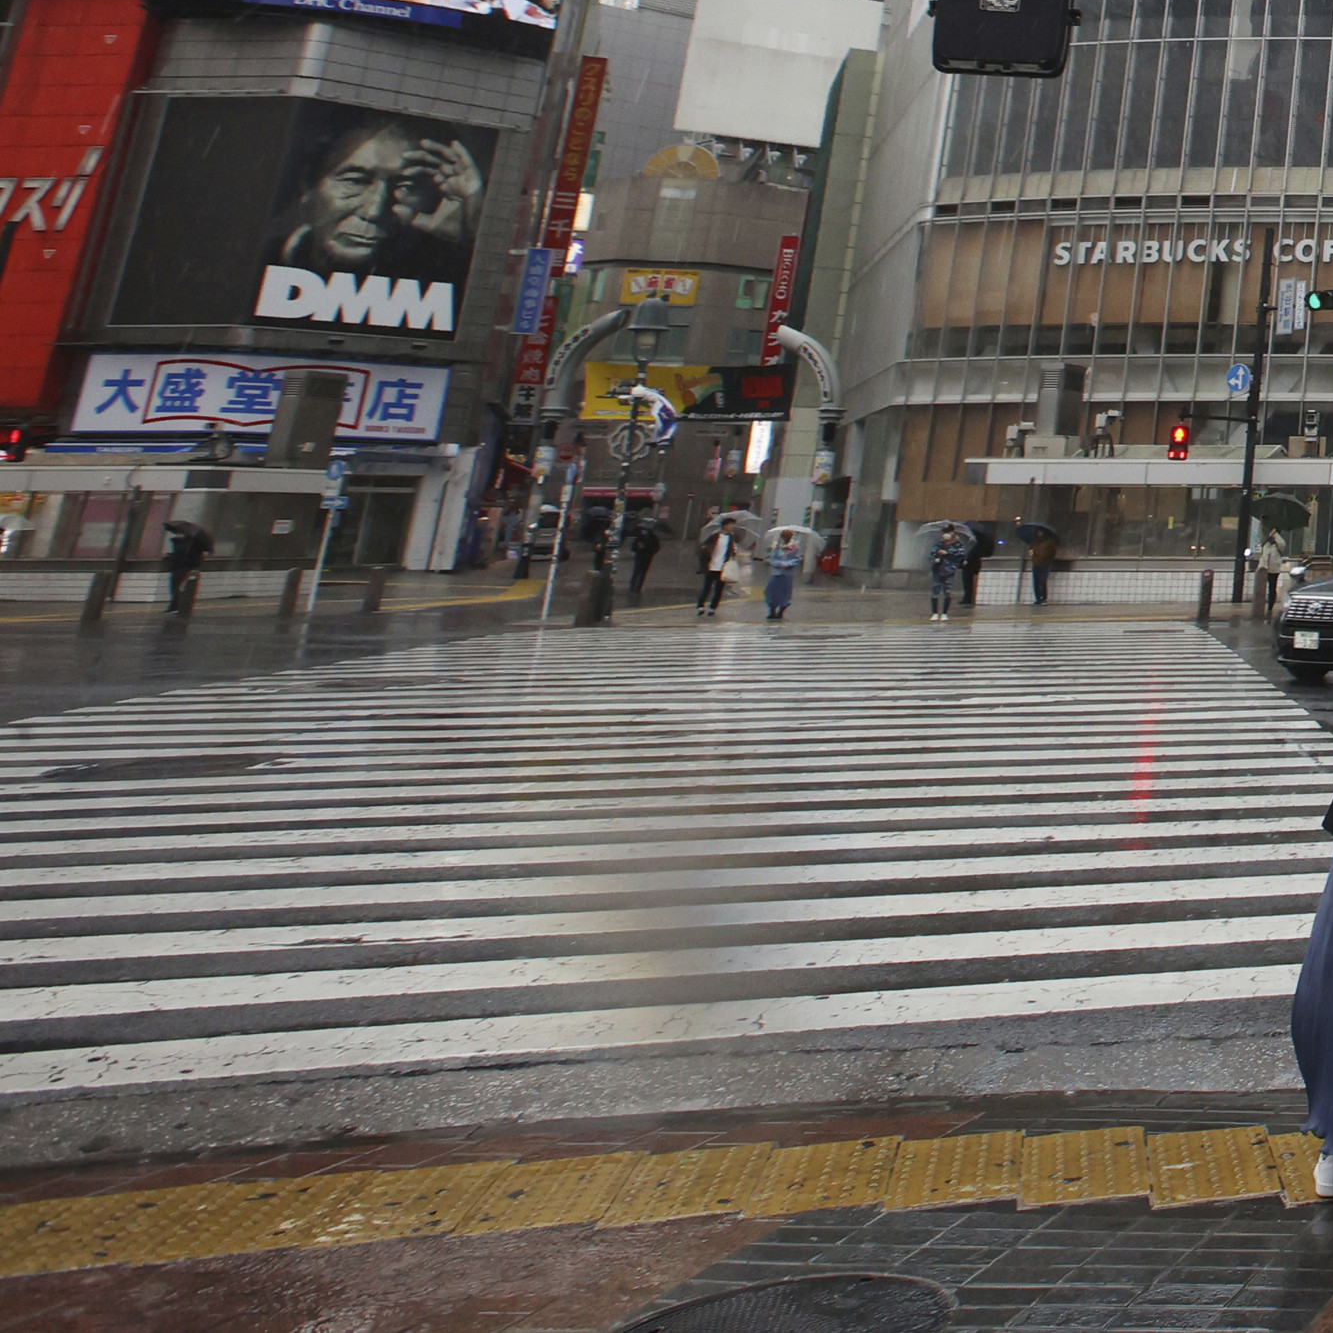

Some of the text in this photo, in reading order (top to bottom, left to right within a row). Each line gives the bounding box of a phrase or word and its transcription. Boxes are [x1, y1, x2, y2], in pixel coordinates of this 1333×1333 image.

[1053, 239, 1251, 266] STARBUCKS
[255, 266, 455, 332] DMM
[96, 369, 424, 422] 大盛堂店
